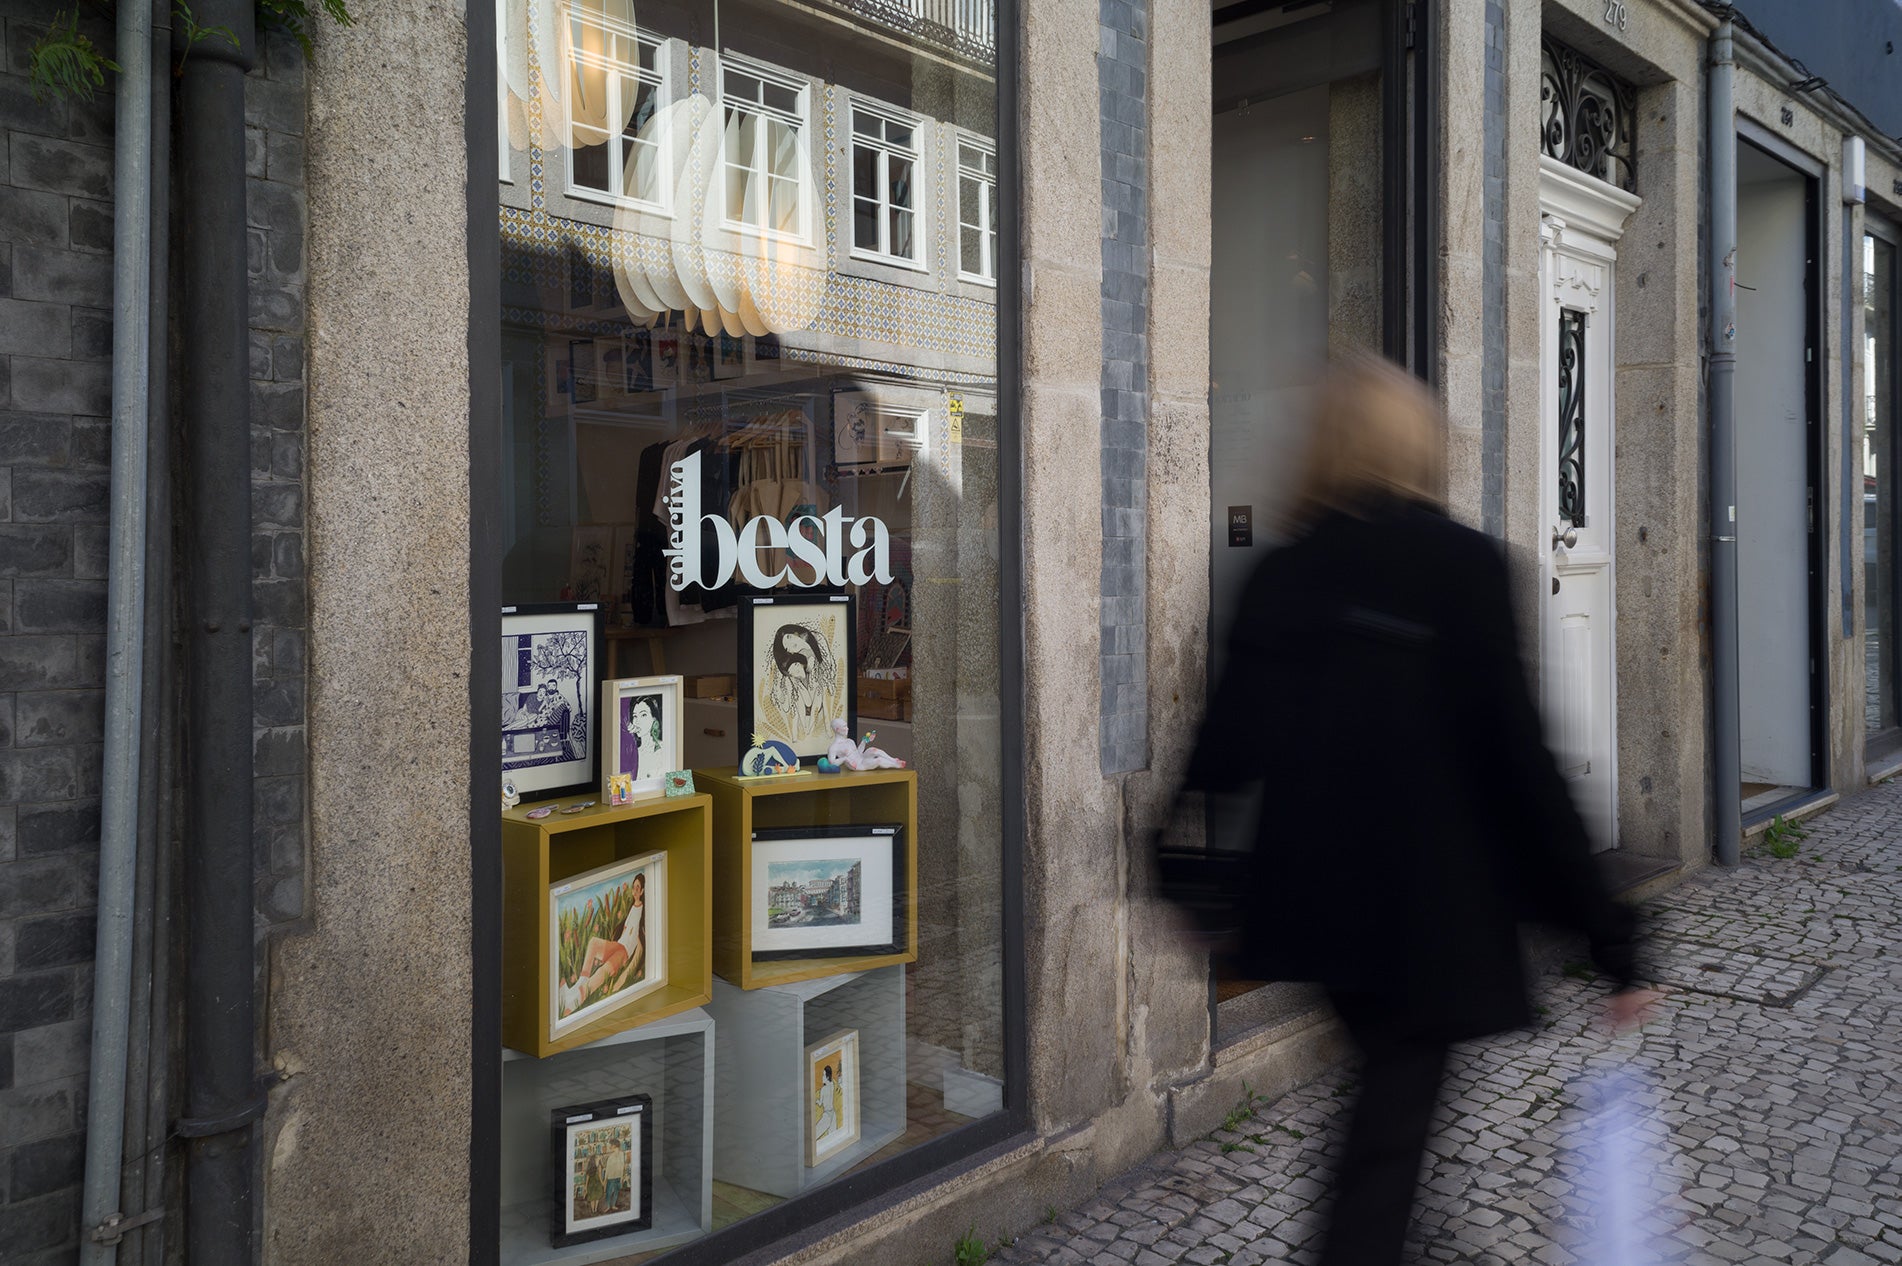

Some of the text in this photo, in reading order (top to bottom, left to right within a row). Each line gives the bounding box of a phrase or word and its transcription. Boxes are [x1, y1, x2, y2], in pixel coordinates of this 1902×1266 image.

[1604, 0, 1626, 31] 279
[661, 460, 685, 590] colectivo
[682, 449, 895, 591] besta
